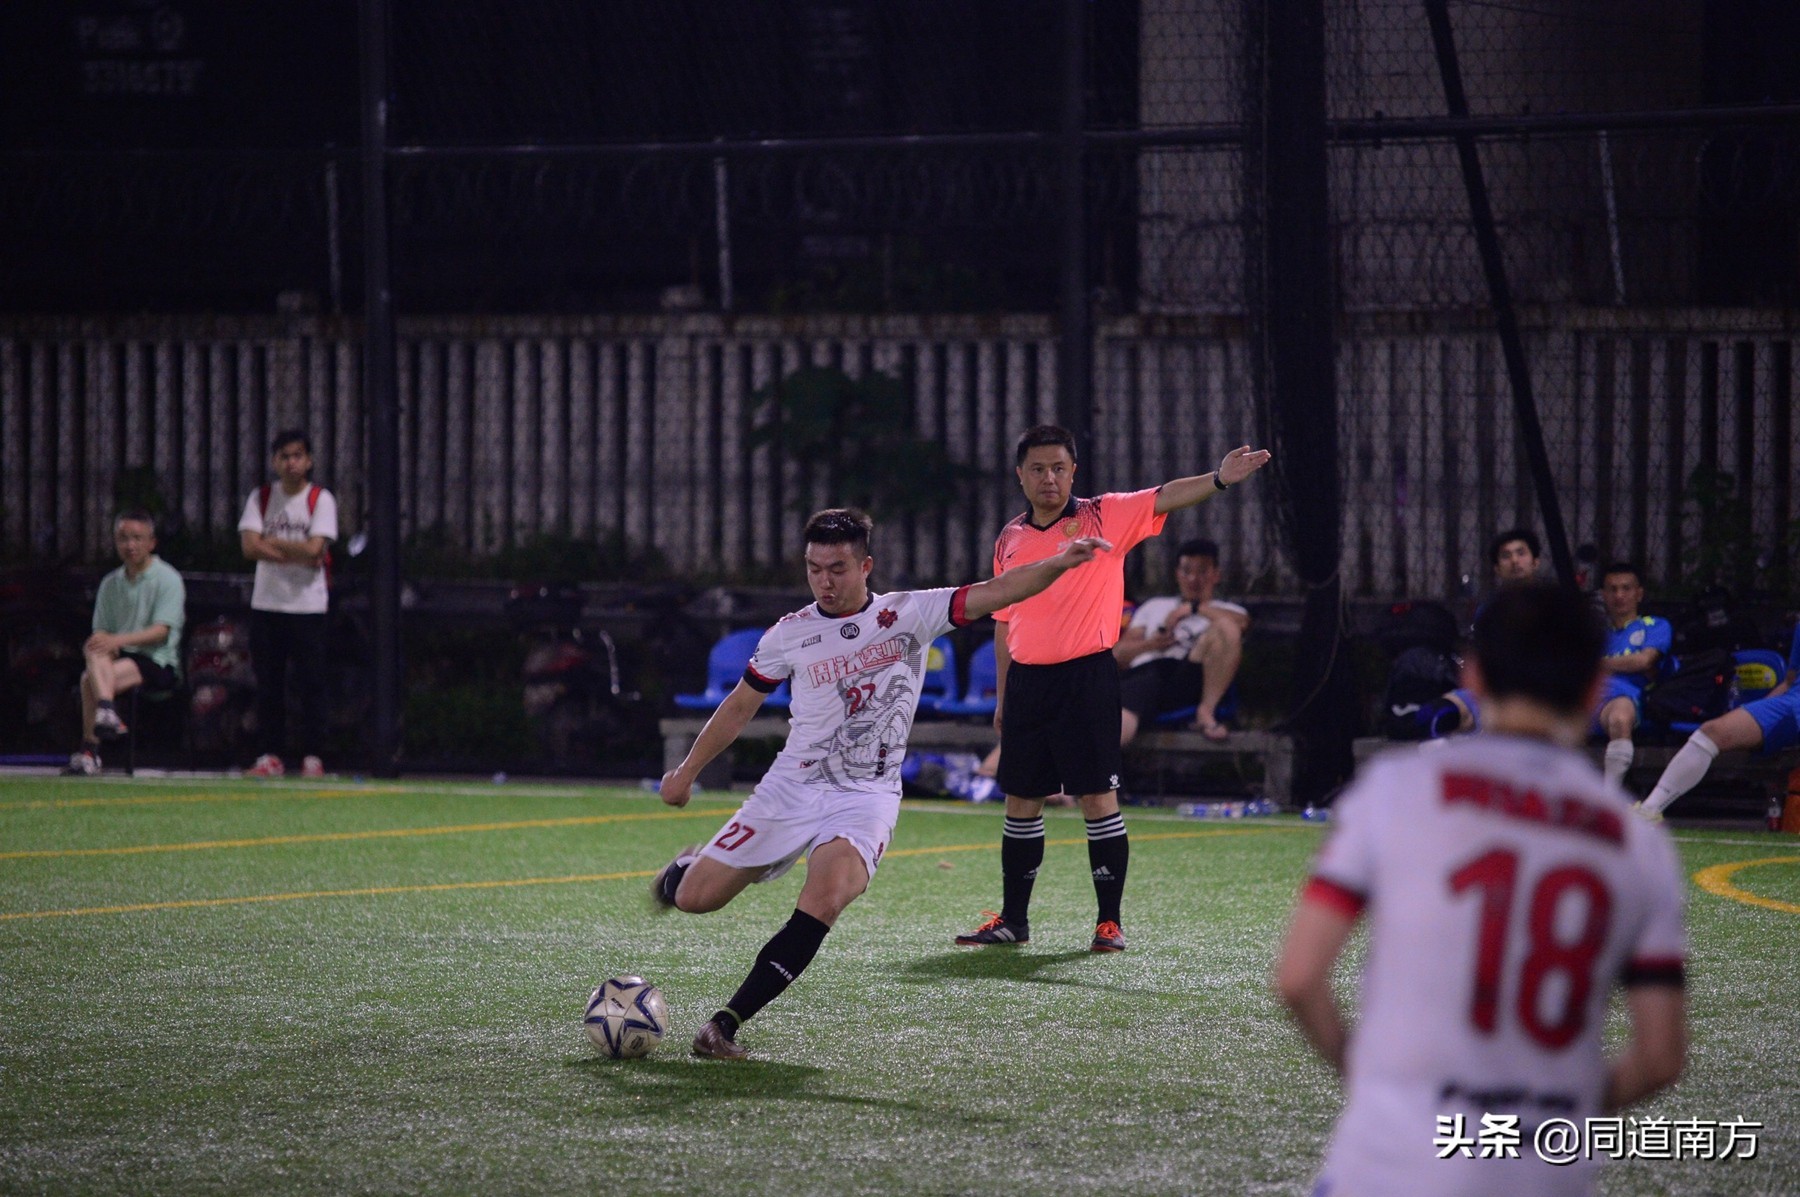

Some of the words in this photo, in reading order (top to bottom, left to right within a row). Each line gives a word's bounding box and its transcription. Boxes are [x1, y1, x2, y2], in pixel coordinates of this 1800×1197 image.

[845, 683, 876, 718] 27
[714, 822, 755, 852] 27
[1448, 845, 1614, 1051] 18
